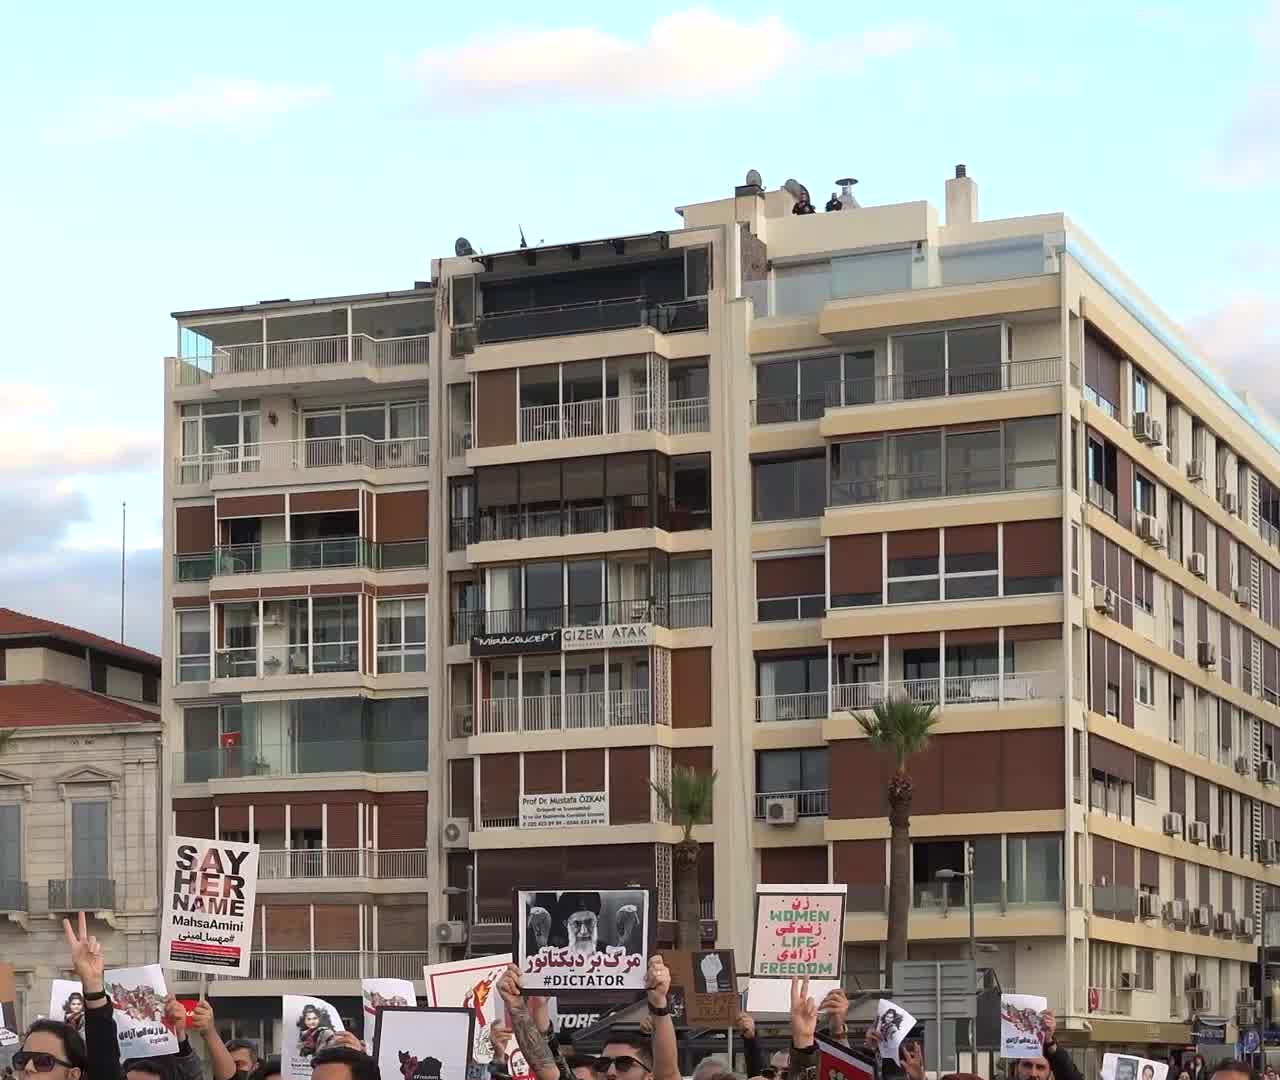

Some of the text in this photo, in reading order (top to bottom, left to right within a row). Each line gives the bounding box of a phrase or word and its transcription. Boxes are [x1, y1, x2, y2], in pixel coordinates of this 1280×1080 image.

[175, 844, 250, 876] SAY
[173, 869, 246, 900] HER
[171, 893, 245, 917] NAME
[791, 896, 810, 910] زن
[172, 914, 244, 932] MahsaAmini
[769, 910, 830, 922] WOMEN
[775, 921, 822, 936] زندگی
[781, 935, 815, 948] LIFE
[777, 942, 819, 962] آزادی
[524, 949, 586, 974] دیکتاتور
[759, 962, 833, 974] FREEDOM
[543, 975, 625, 986] #DICTATOR
